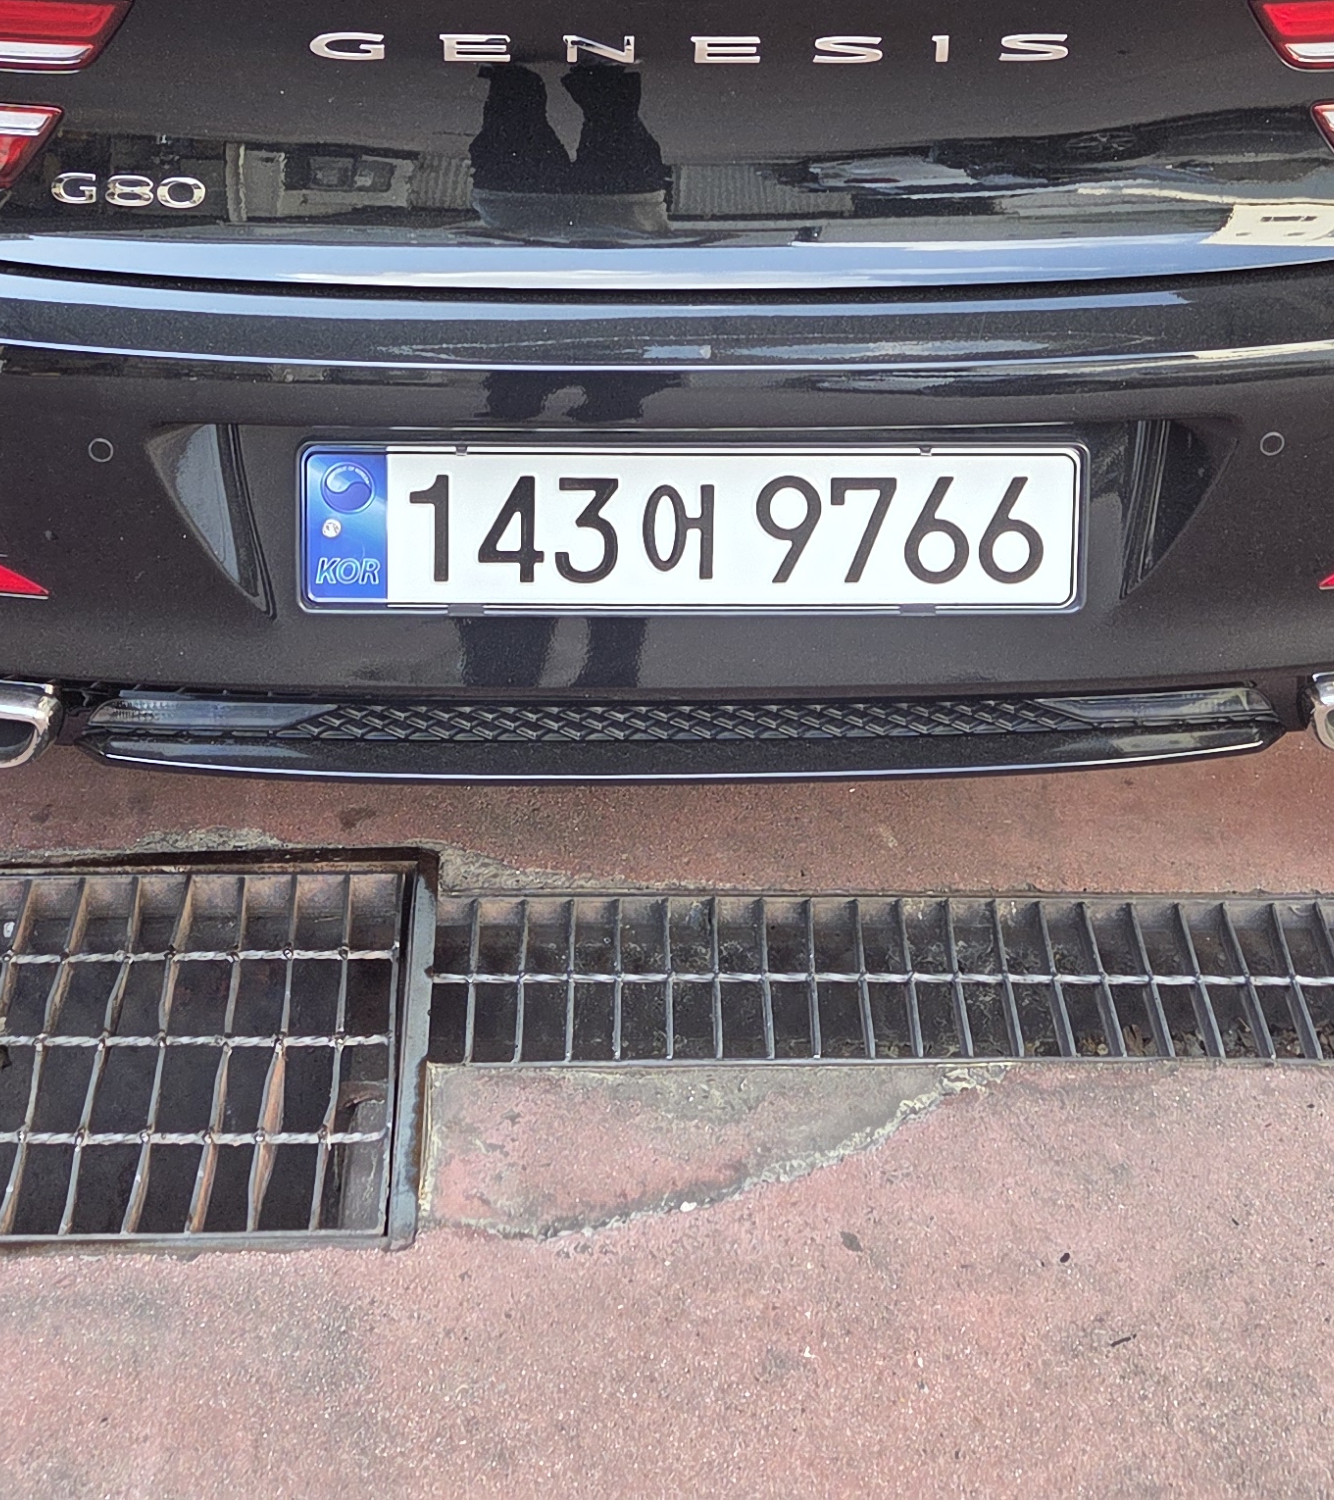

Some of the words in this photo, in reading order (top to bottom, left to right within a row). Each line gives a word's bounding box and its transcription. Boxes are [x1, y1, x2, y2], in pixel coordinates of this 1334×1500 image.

[308, 31, 1070, 64] GENESIS
[50, 171, 207, 209] G80
[408, 473, 715, 584] 143어
[755, 475, 1045, 584] 9766
[315, 556, 381, 585] KOR
